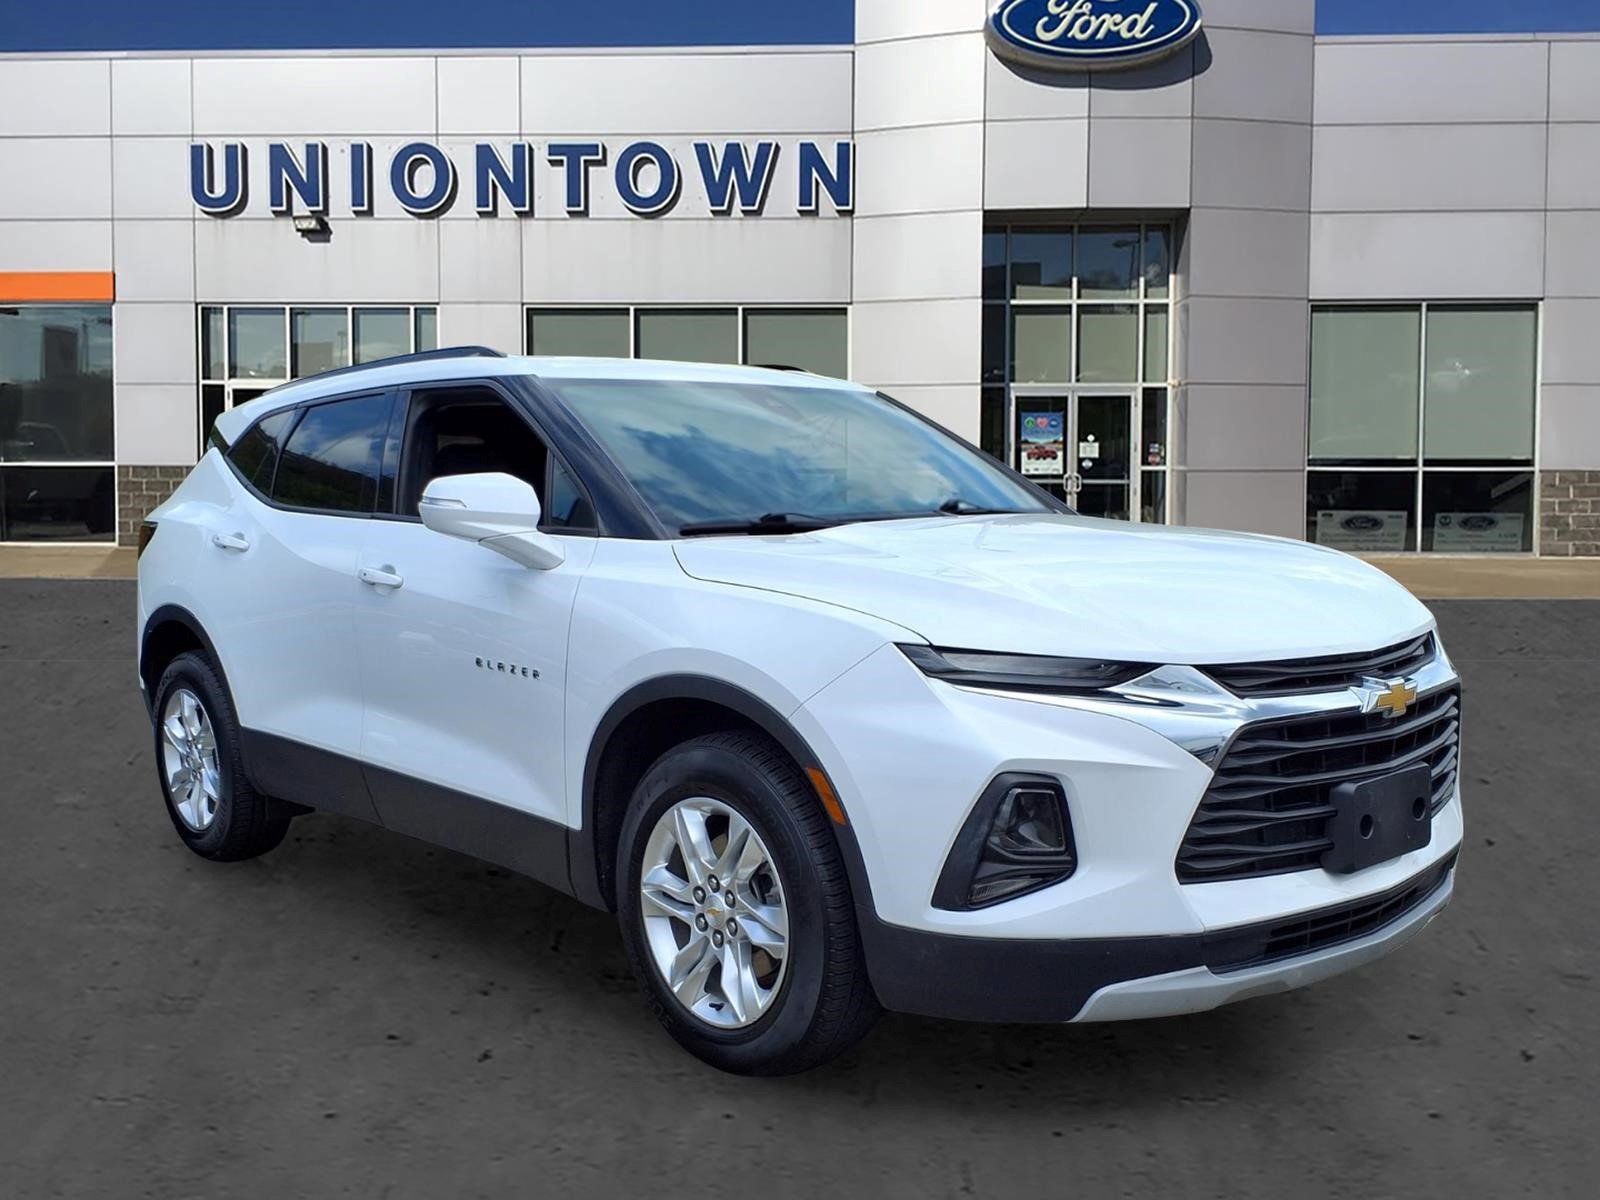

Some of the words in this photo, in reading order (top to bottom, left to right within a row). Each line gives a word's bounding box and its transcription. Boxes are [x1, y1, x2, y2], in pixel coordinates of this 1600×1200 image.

[1035, 0, 1158, 41] Ford
[189, 140, 855, 217] UNIONTOWN
[475, 657, 541, 680] BLAZER
